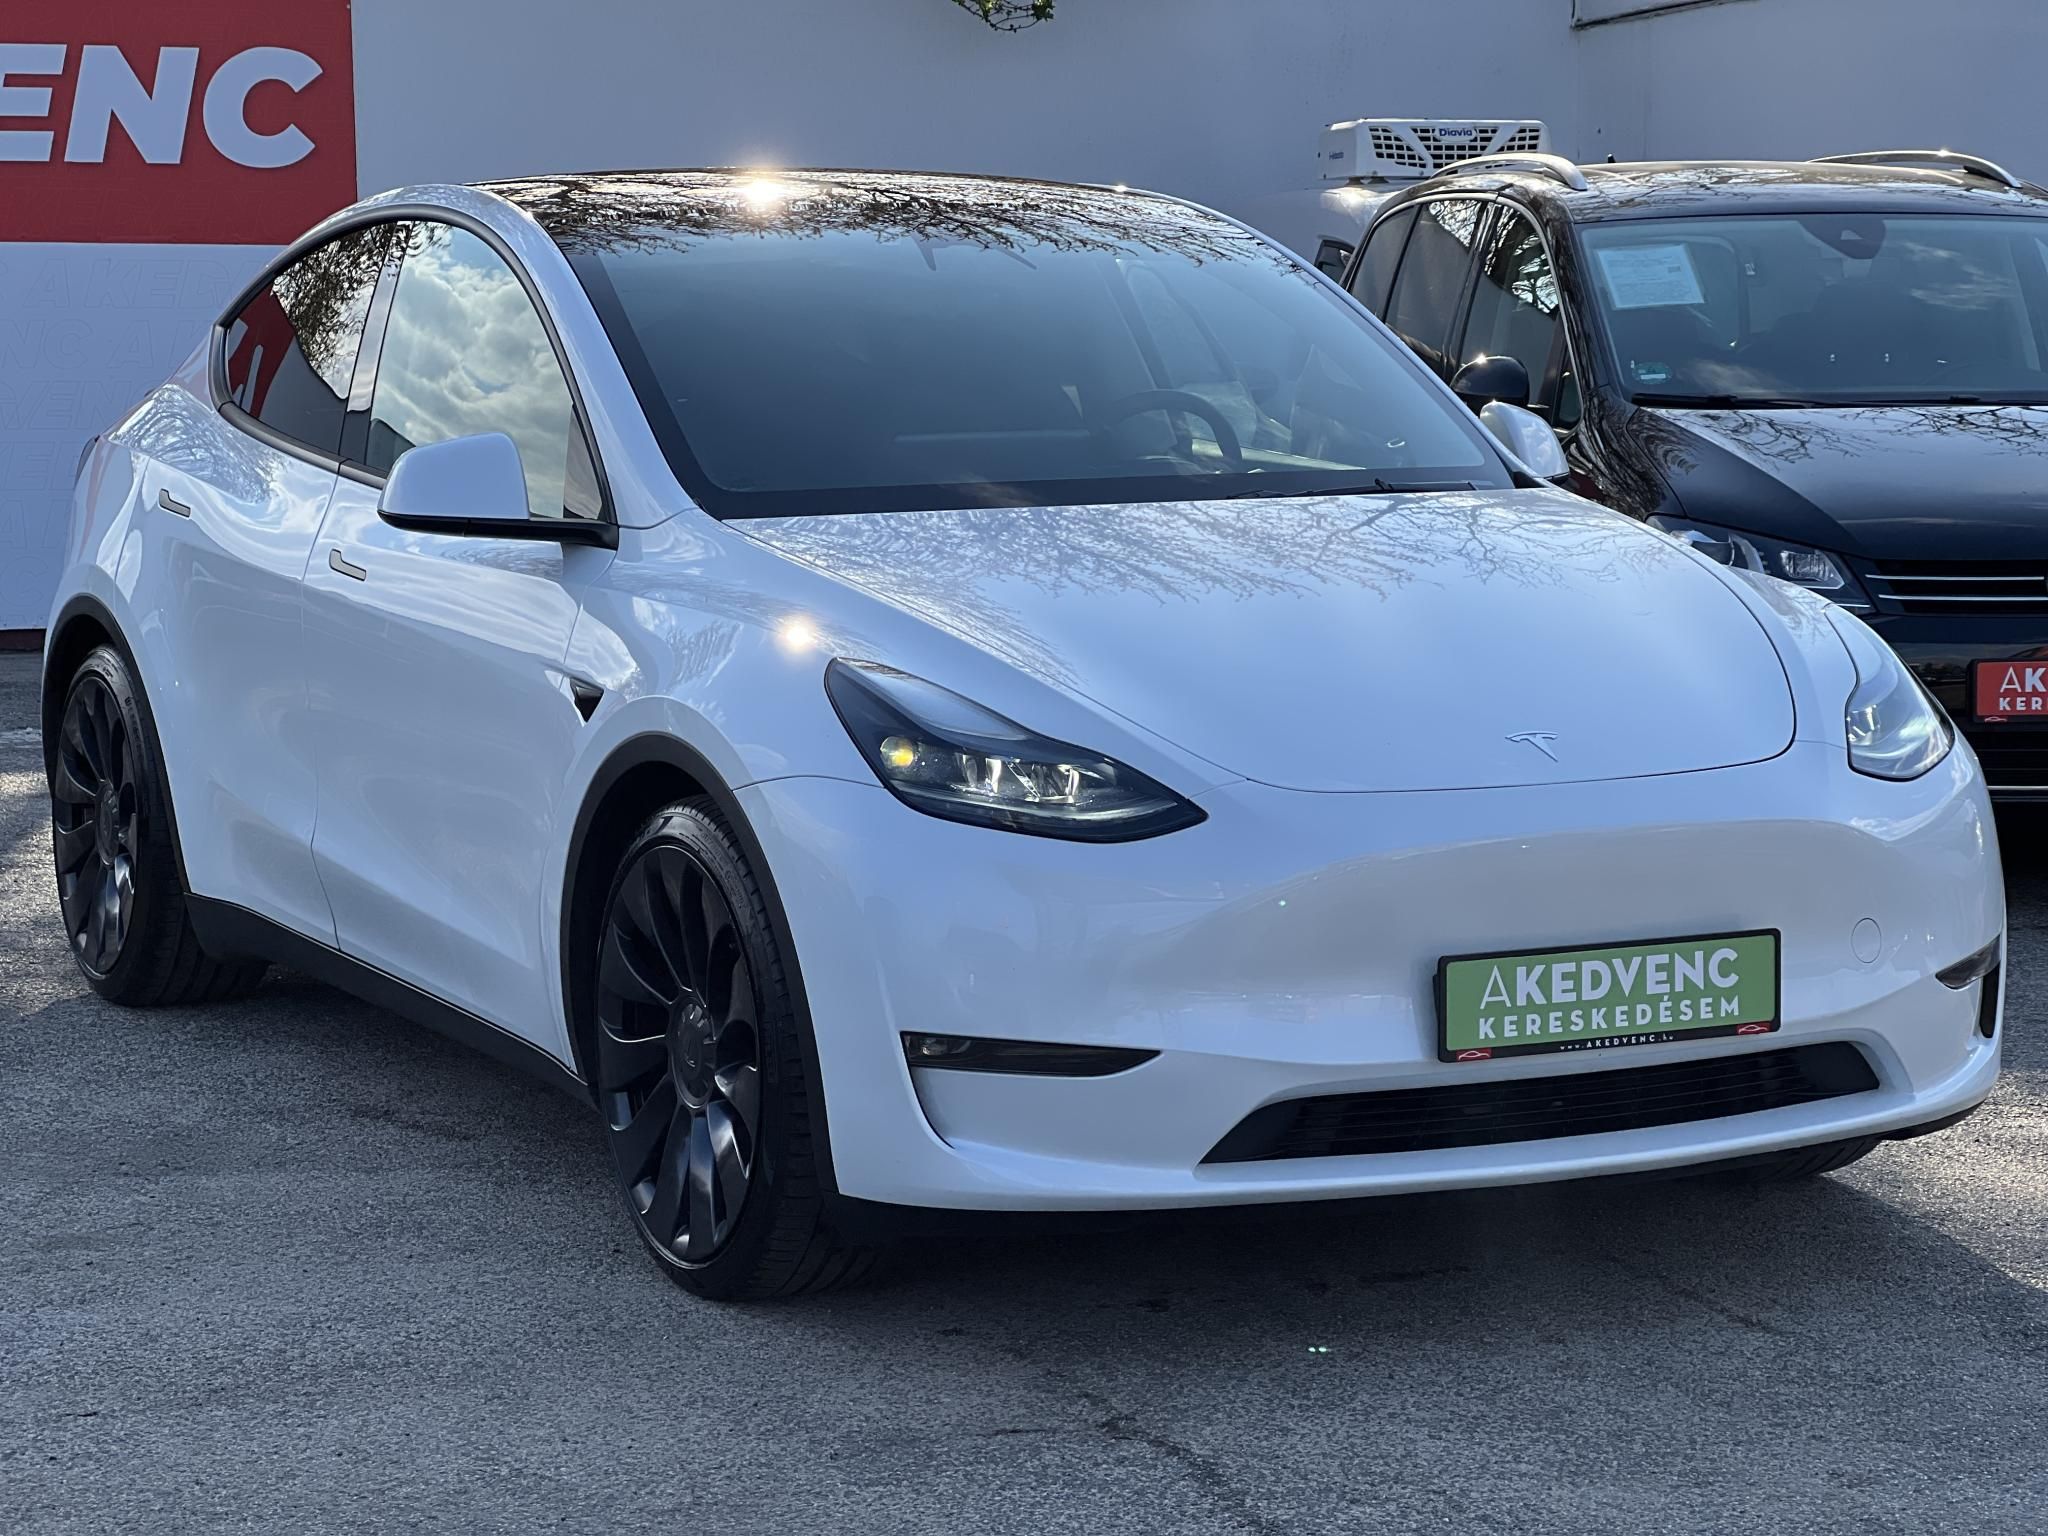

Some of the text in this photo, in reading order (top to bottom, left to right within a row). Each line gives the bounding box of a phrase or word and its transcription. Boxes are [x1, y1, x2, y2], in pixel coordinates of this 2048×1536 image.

[1439, 128, 1472, 136] Diavia
[1480, 948, 1739, 1009] AKEDVENC
[1479, 995, 1739, 1039] KERESKEDÉSEM
